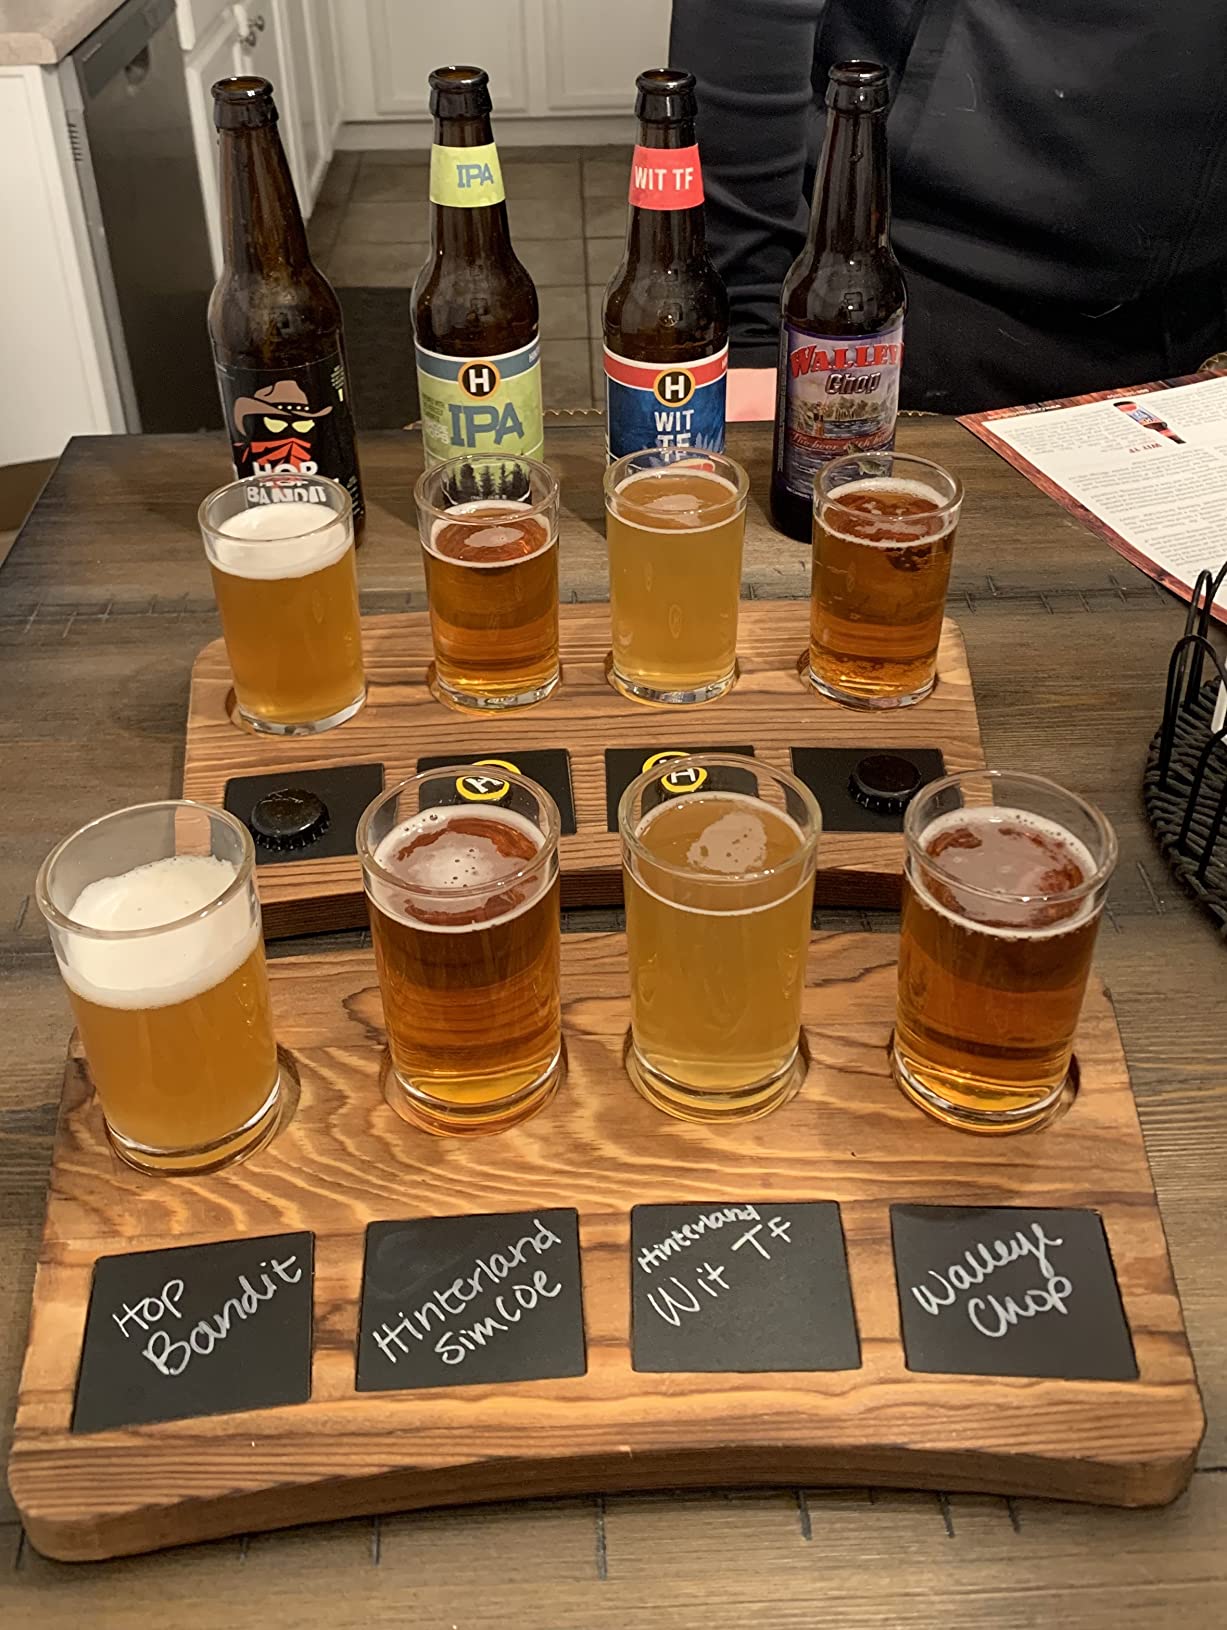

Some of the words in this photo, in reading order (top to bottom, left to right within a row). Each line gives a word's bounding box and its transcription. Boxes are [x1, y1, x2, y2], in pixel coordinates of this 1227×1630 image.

[456, 163, 494, 188] IPA
[635, 165, 667, 191] WIT
[672, 167, 694, 190] TF
[789, 341, 904, 379] WALLEY
[468, 368, 490, 393] H
[665, 375, 685, 399] H
[448, 402, 524, 448] IPA
[654, 410, 694, 432] WIT
[247, 486, 327, 504] BANDIT
[637, 1204, 761, 1274] Hinterland
[372, 1218, 562, 1363] Hinterland
[647, 1262, 730, 1327] Wit
[731, 1216, 792, 1260] TF
[142, 1255, 302, 1376] Bandit
[968, 1276, 1073, 1338] Chop
